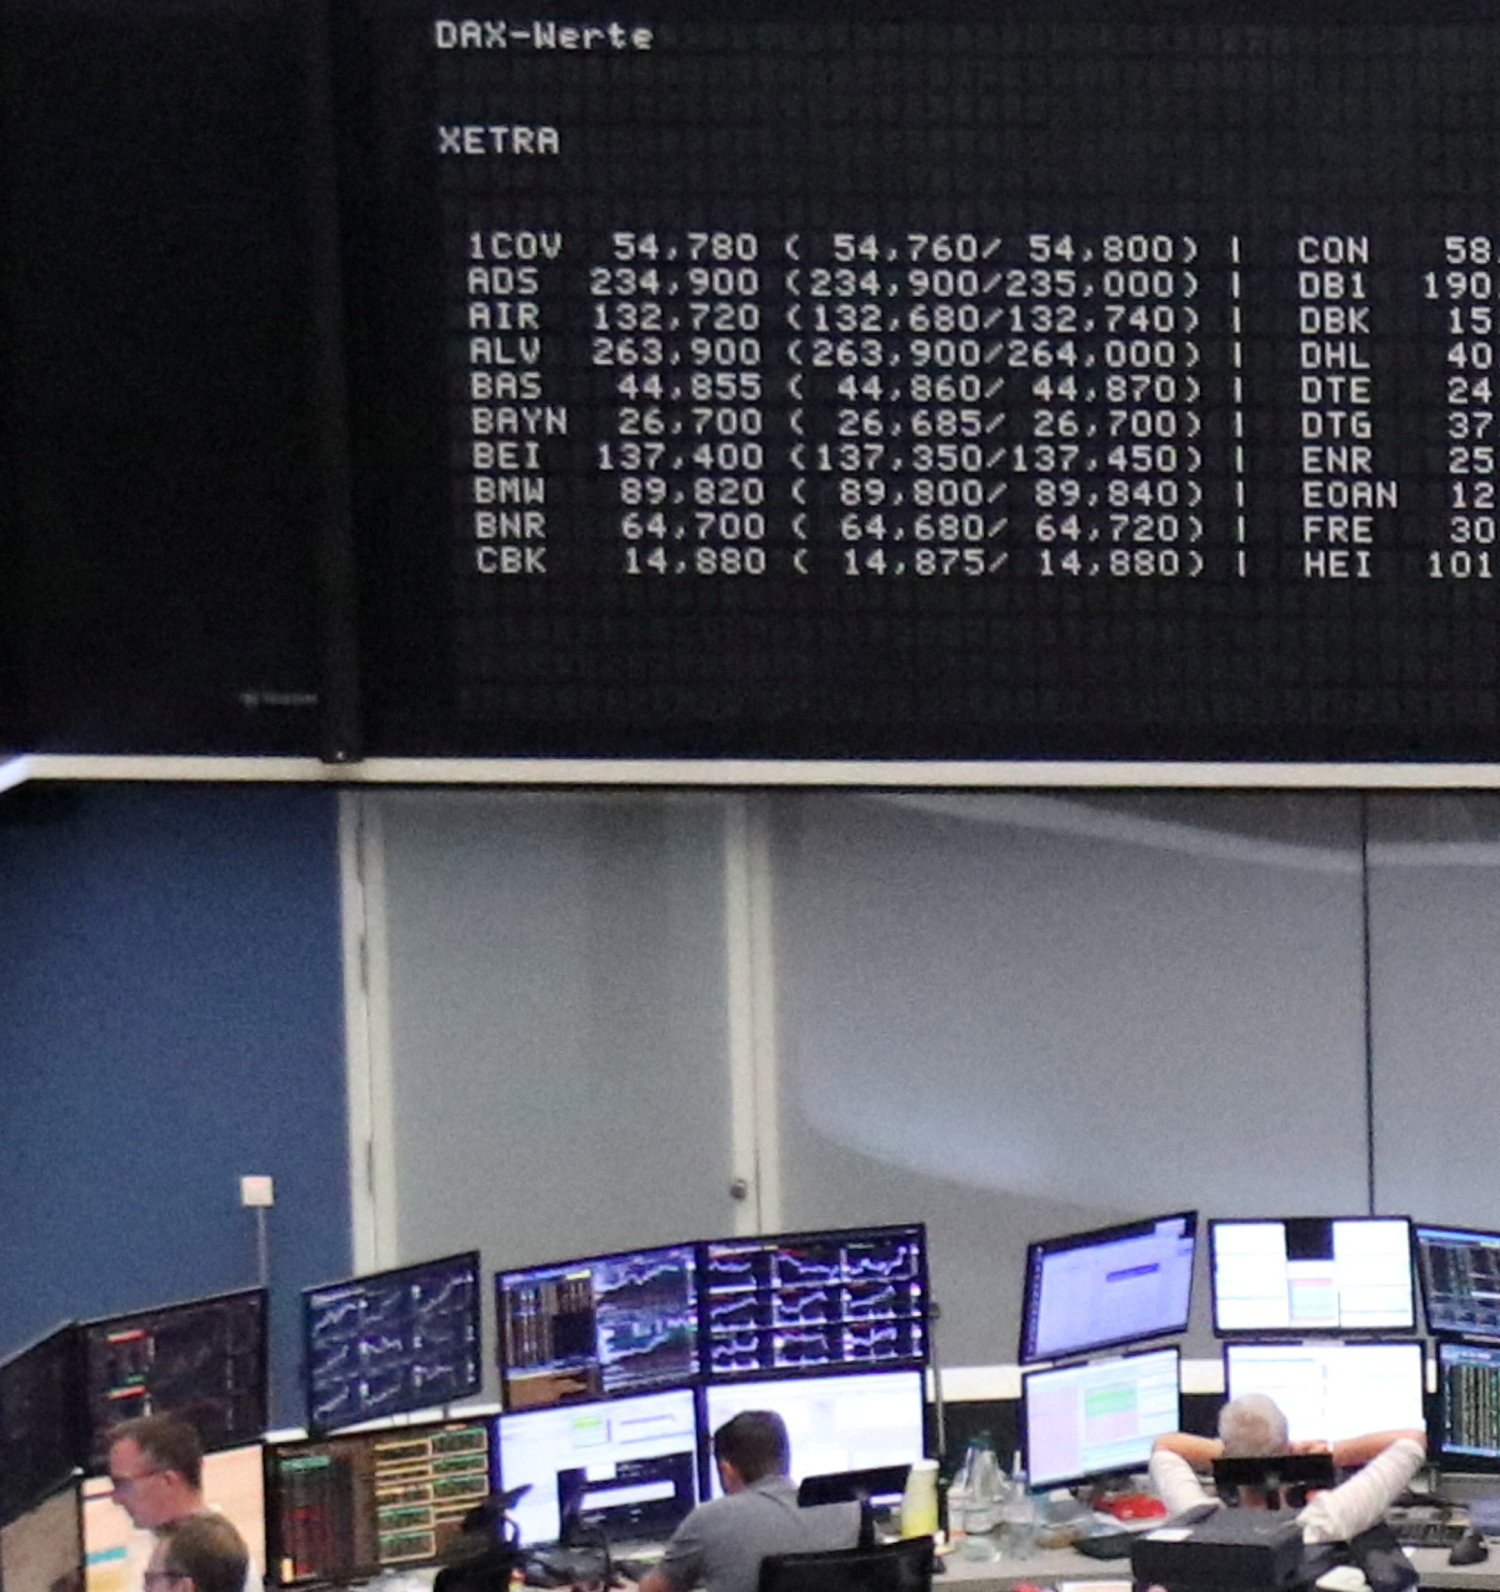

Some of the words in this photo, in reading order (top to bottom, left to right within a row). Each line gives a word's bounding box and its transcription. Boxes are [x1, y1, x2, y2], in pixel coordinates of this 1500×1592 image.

[434, 19, 654, 50] DAX-Werte
[438, 125, 560, 155] XETRA
[469, 230, 563, 261] 1COV
[612, 231, 758, 262] 54,780
[1297, 234, 1370, 265] CON
[467, 265, 539, 296] ADS
[590, 266, 759, 297] 234,900
[1298, 269, 1366, 300] DB1
[468, 300, 540, 331] AIR
[594, 301, 760, 332] 132,720
[1299, 305, 1370, 335] DBK
[469, 336, 541, 365] ALV
[592, 336, 761, 367] 263,900
[1299, 340, 1371, 370] DHL
[470, 370, 542, 401] BAS
[617, 371, 762, 402] 44,855
[1300, 374, 1372, 405] DTE
[471, 406, 568, 435] BAYN
[618, 406, 763, 437] 26,700
[1300, 409, 1373, 440] DTG
[472, 440, 540, 470] BEI
[598, 441, 764, 471] 137,400
[1301, 444, 1373, 475] ENR
[473, 475, 545, 505] BMW
[620, 476, 765, 506] 89,820
[1302, 479, 1398, 510] EOAN
[474, 510, 546, 540] BNR
[620, 511, 766, 541] 64,700
[1302, 514, 1374, 545] FRE
[476, 545, 547, 574] CBK
[626, 546, 767, 576] 14,880
[1303, 549, 1371, 579] HEI
